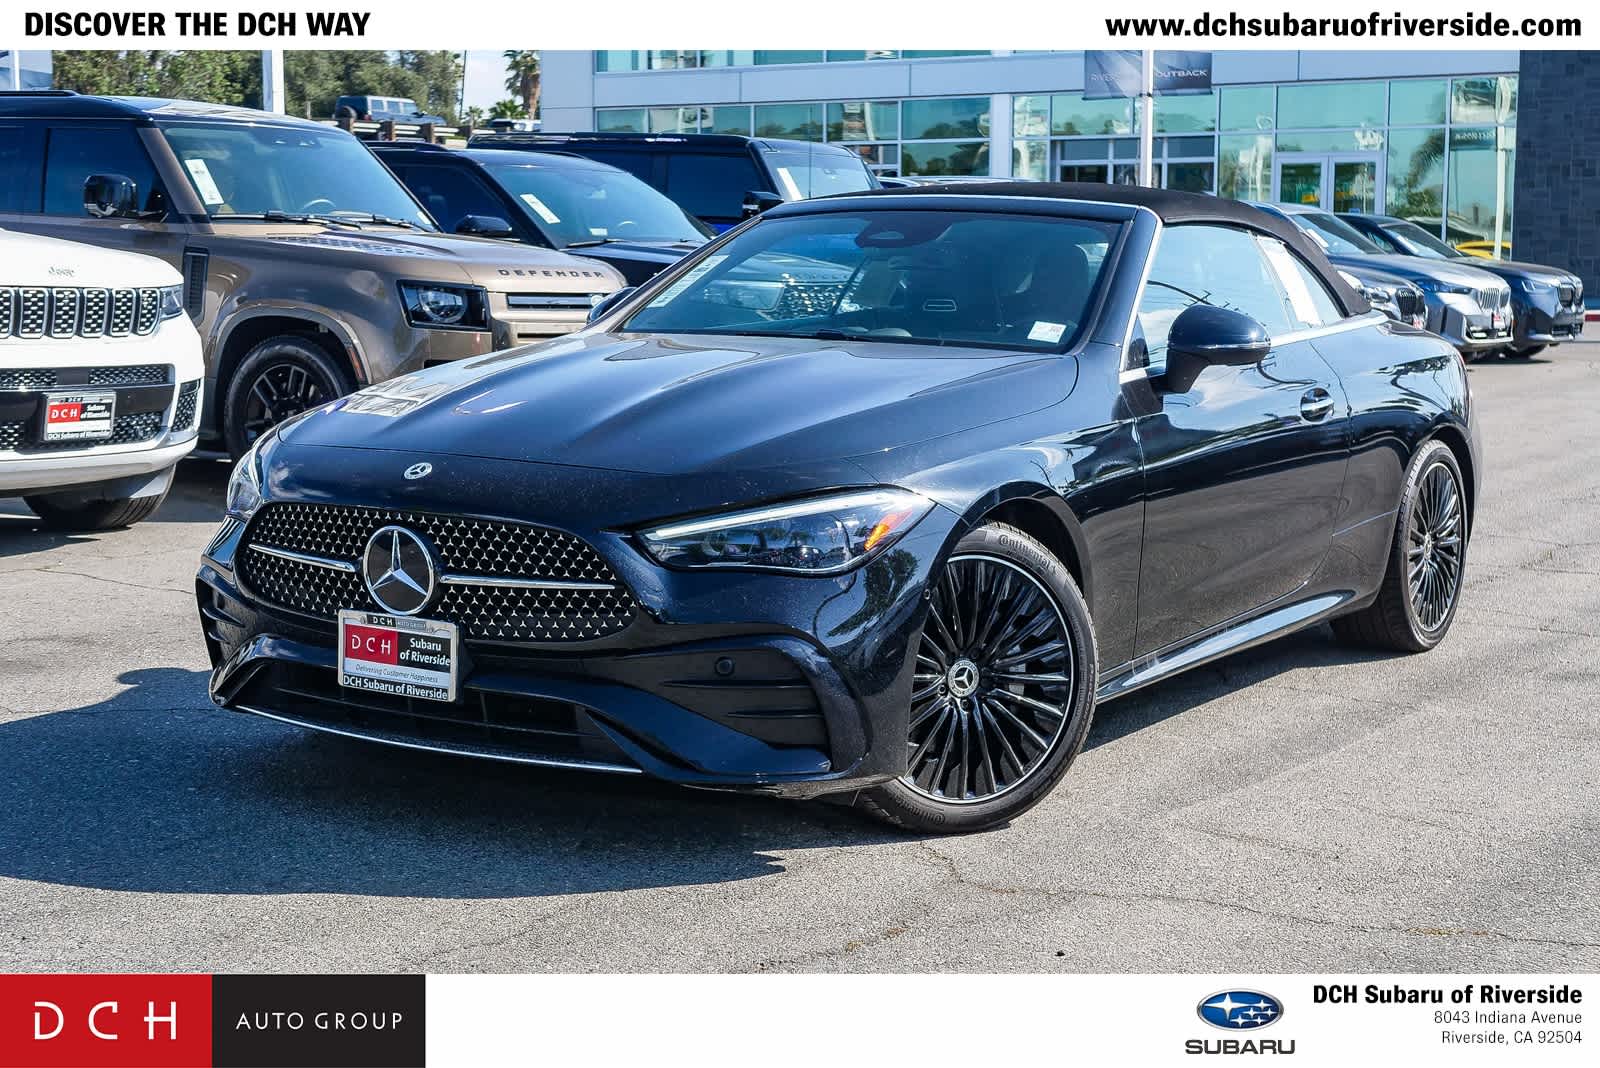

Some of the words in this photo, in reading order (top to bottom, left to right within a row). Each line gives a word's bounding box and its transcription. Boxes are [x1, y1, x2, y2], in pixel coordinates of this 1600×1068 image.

[497, 268, 605, 279] DEFENDER
[51, 408, 79, 419] DCH
[371, 616, 394, 626] DCH
[351, 633, 392, 656] DCH
[410, 637, 442, 651] Subaru
[400, 649, 410, 660] of
[411, 650, 451, 667] Riverside
[343, 674, 362, 687] DCH
[363, 677, 394, 692] Subaru
[395, 683, 406, 694] of
[406, 684, 448, 701] Riverside
